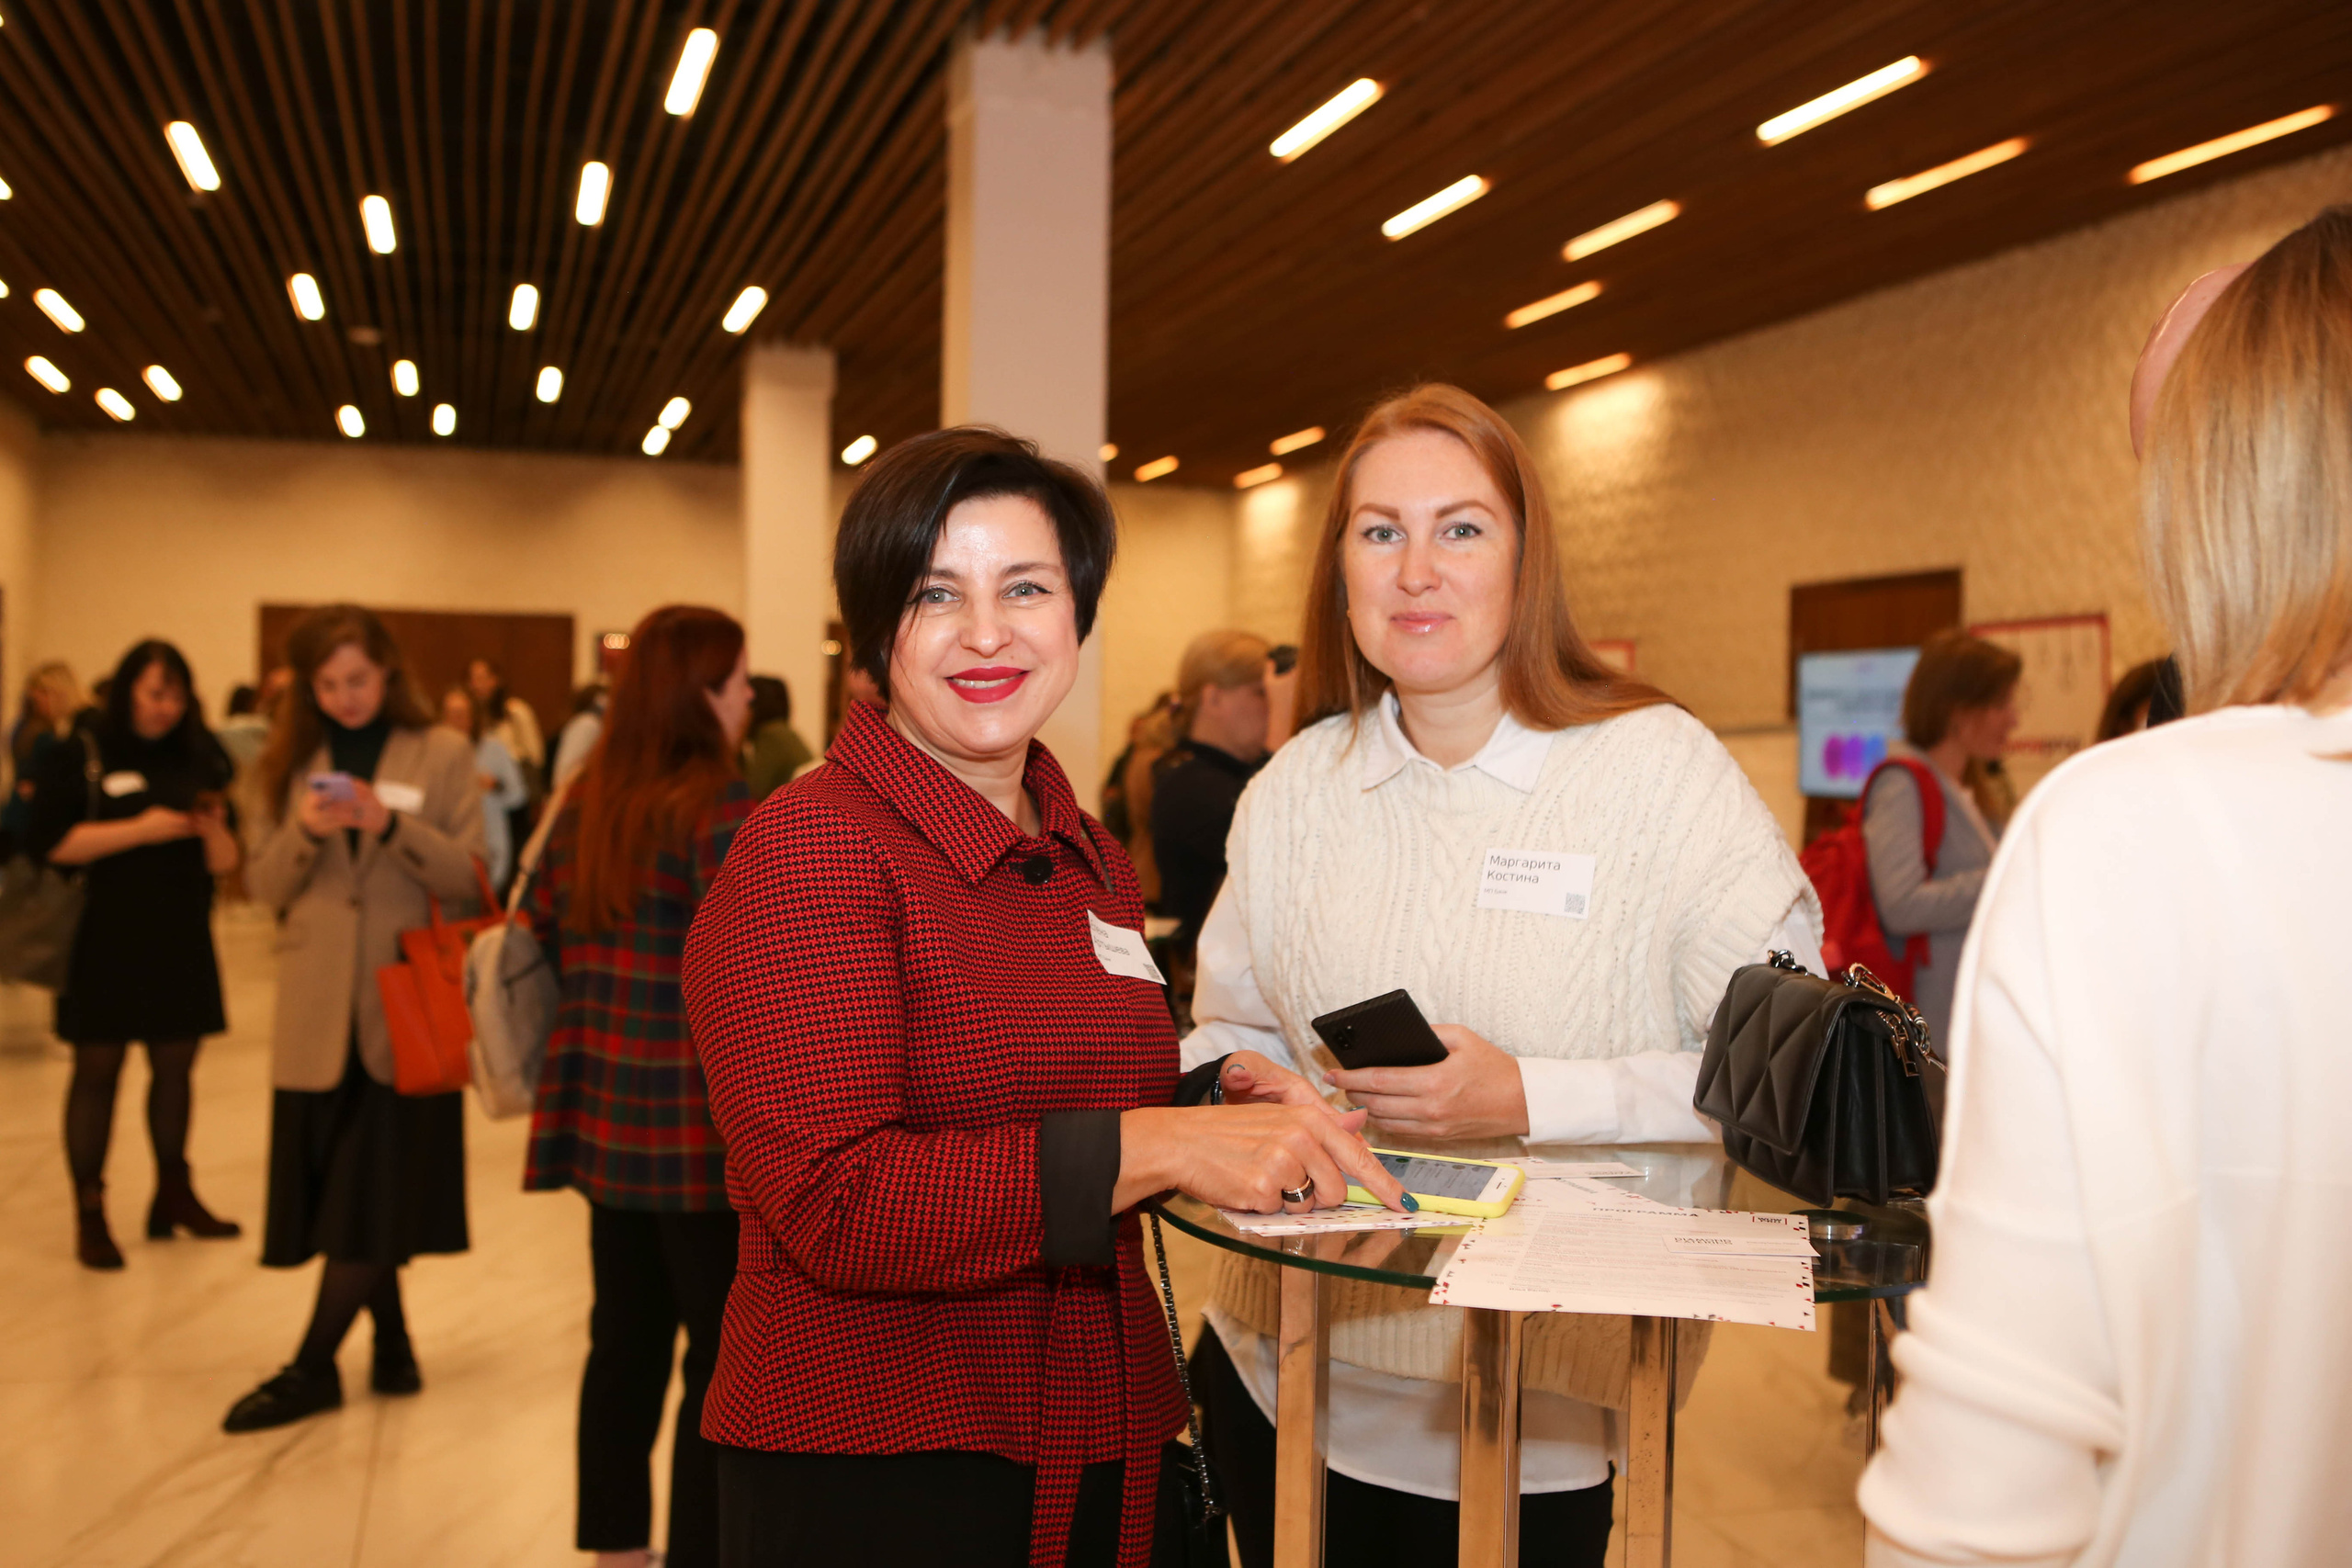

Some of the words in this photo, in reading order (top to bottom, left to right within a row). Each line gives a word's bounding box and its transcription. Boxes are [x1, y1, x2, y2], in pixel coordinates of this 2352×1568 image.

[1489, 855, 1561, 871] Маргарита
[1487, 870, 1539, 883] Костина
[1593, 1207, 1699, 1217] ПРОГРАММА
